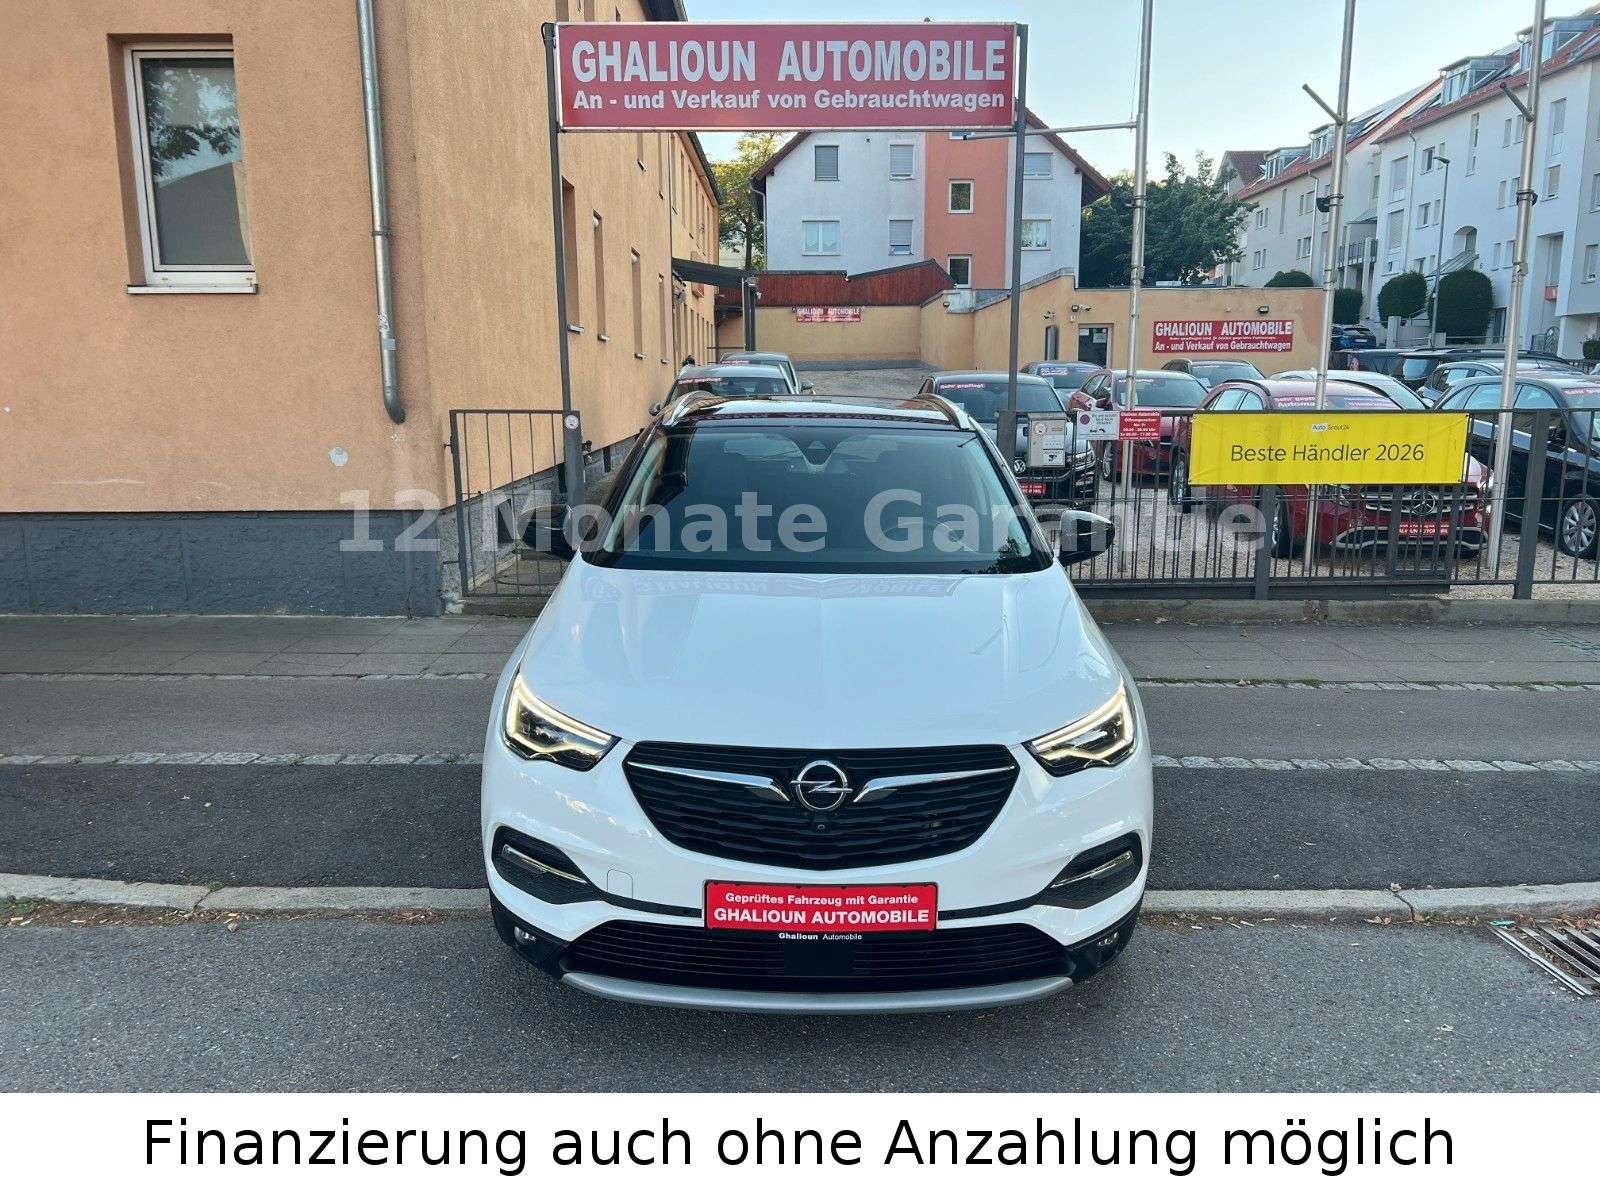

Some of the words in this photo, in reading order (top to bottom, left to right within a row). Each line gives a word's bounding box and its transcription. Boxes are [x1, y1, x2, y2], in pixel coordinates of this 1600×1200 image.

[571, 40, 756, 82] GHALIOUN
[777, 39, 1006, 81] AUTOMOBILE
[573, 91, 602, 110] An
[624, 90, 664, 109] und
[671, 89, 760, 109] Verkauf
[767, 93, 807, 109] von
[814, 89, 1005, 114] Gebrauchtwagen
[1155, 321, 1214, 337] GHALIOUN
[1221, 321, 1293, 336] AUTOMOBILE
[1155, 341, 1165, 351] An
[1171, 341, 1184, 351] und
[1186, 340, 1215, 351] Verkauf
[1216, 342, 1229, 350] von
[1230, 340, 1291, 352] Gebrauchtwagen
[1231, 444, 1286, 461] Beste
[1293, 443, 1370, 461] Händler
[1375, 443, 1424, 461] 2026
[725, 893, 784, 906] Geprüftes
[787, 894, 842, 906] Fahrzeug
[845, 894, 865, 905] mit
[868, 894, 918, 905] Garantie
[713, 907, 807, 924] GHALIOUN
[811, 909, 929, 925] AUTOMOBILE
[778, 932, 818, 941] Ghalioun
[822, 933, 863, 941] Automobile
